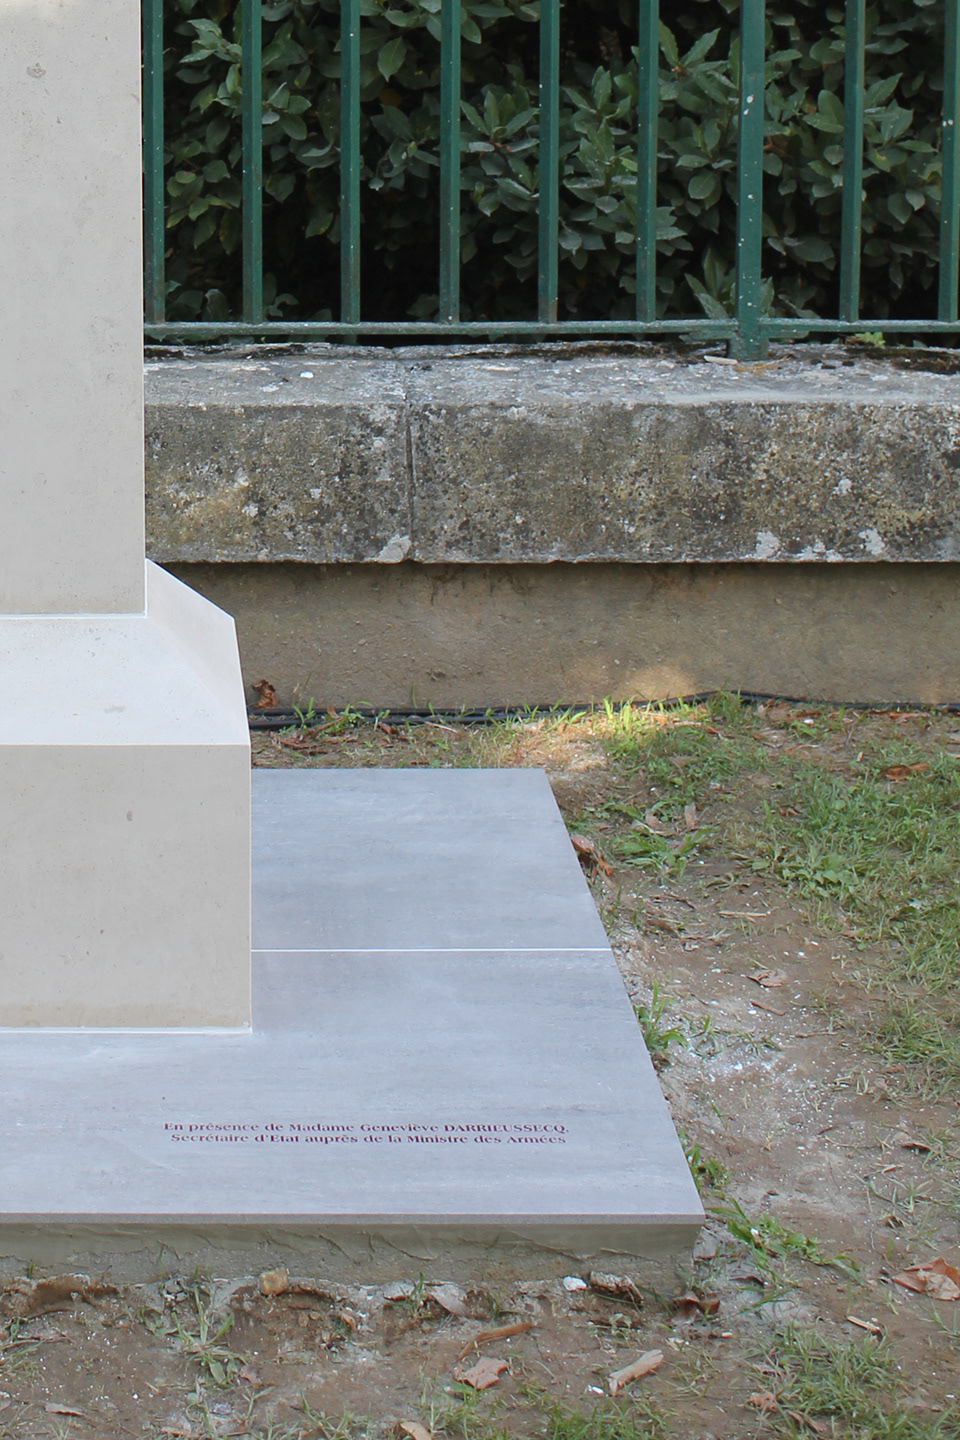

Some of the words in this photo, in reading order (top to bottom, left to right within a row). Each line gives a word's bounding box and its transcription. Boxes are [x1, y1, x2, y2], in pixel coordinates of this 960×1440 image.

[164, 1123, 183, 1131] En
[188, 1122, 259, 1132] présence
[264, 1123, 284, 1131] de
[289, 1123, 355, 1132] Madame
[360, 1123, 439, 1132] Geneviève
[171, 1133, 249, 1142] Secrétaire
[305, 1134, 358, 1144] auprès
[363, 1135, 382, 1143] de
[388, 1135, 402, 1143] la
[407, 1134, 468, 1143] Ministre
[474, 1135, 502, 1143] des
[506, 1134, 567, 1143] Armées
